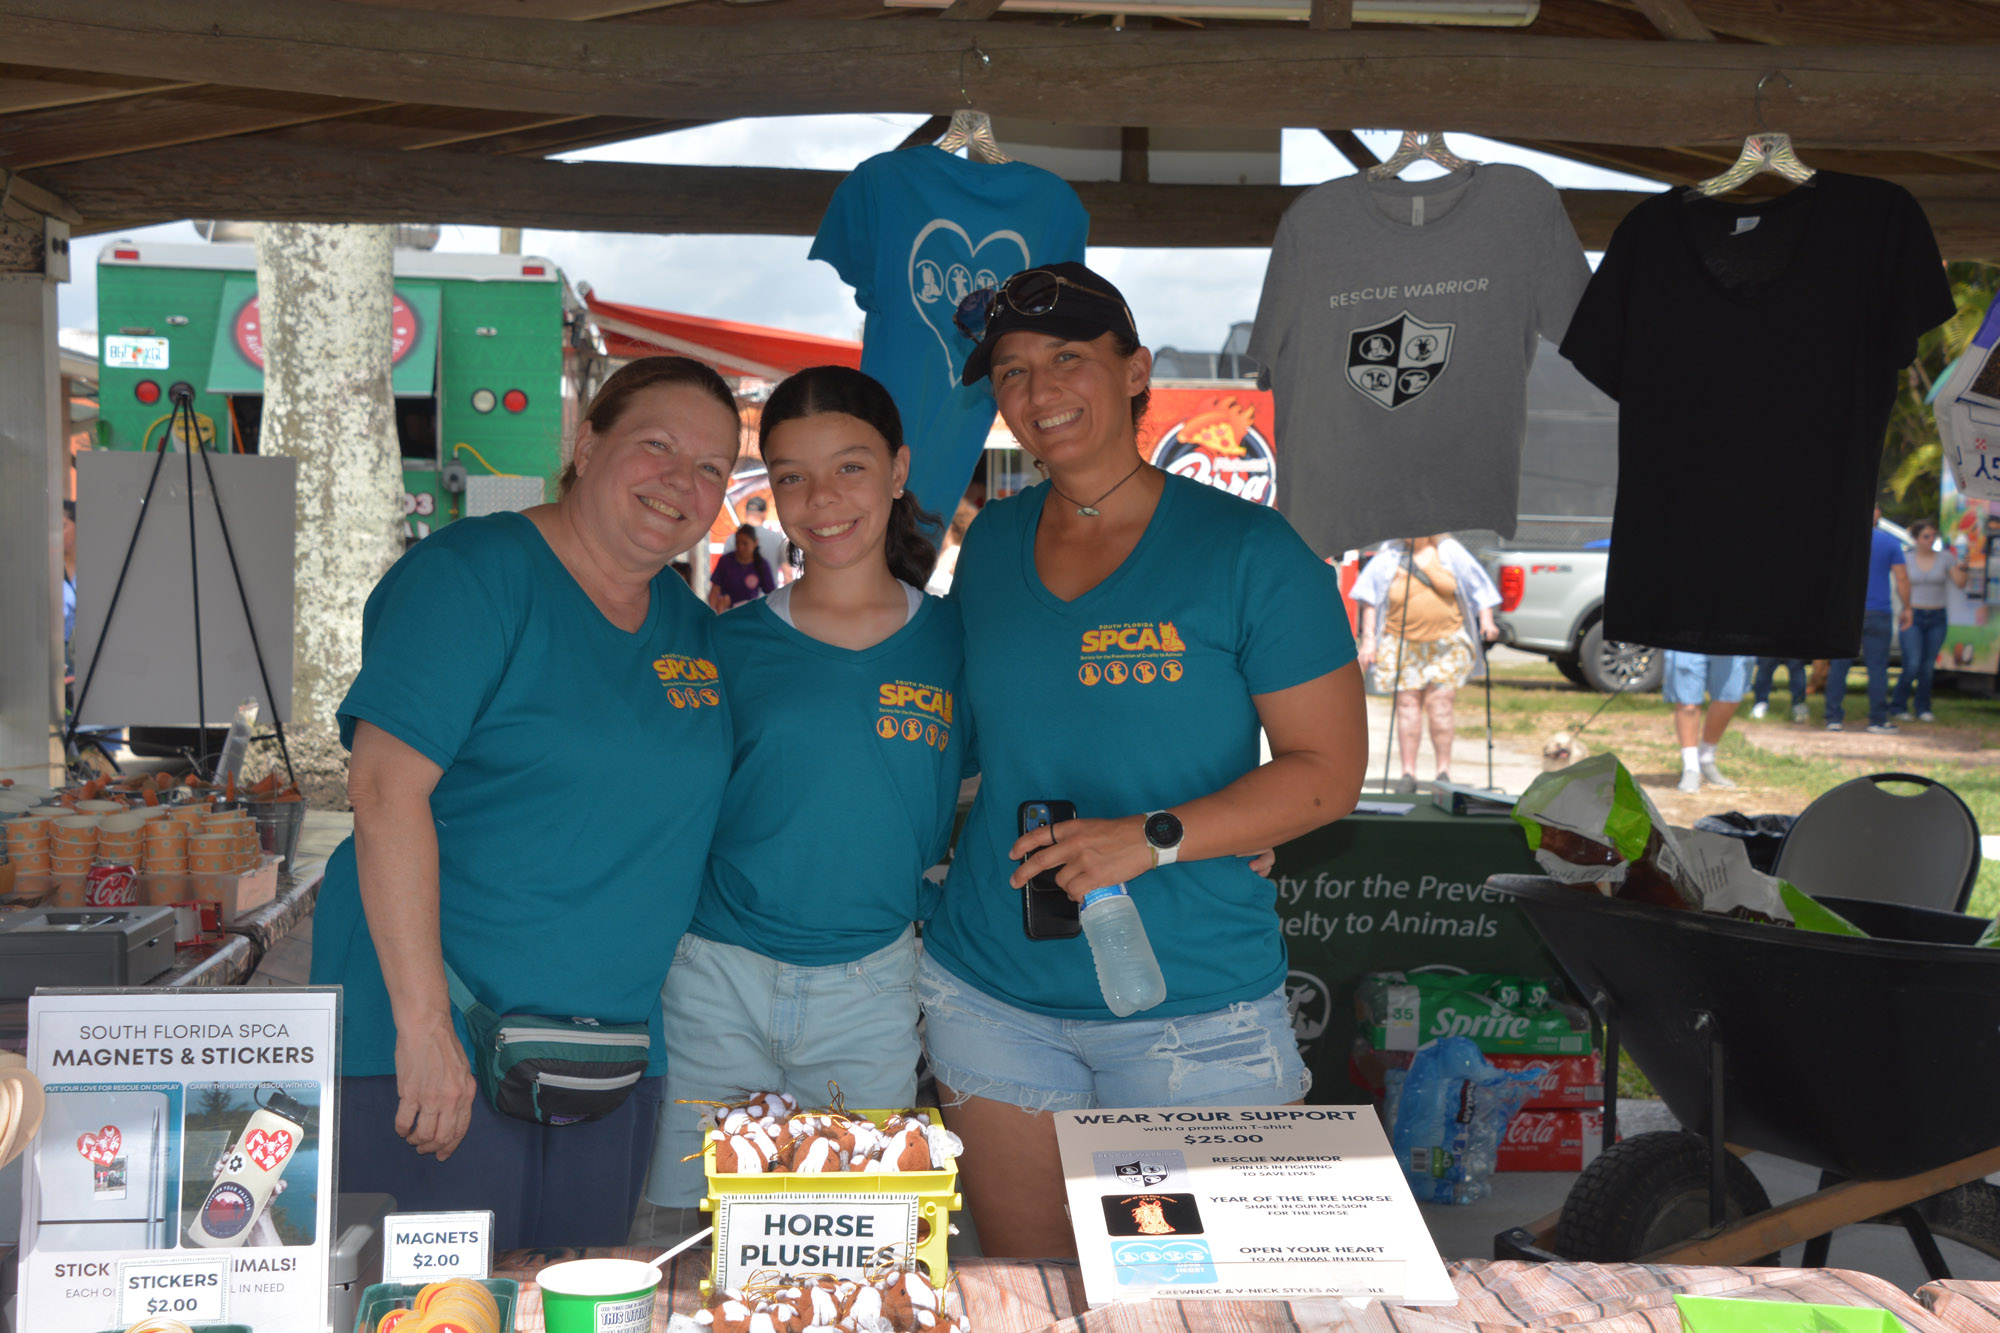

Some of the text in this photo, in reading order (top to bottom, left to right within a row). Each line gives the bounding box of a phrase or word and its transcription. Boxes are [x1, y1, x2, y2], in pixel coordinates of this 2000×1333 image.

[1330, 277, 1489, 308] RESCUE WARRIOR
[1081, 628, 1161, 653] SPCA
[652, 658, 709, 681] SPCA
[895, 680, 943, 694] SOUTH FLORIDA
[879, 683, 945, 718] SPCA
[1314, 872, 1355, 899] for
[1362, 873, 1410, 899] the
[1345, 912, 1374, 934] to
[1380, 909, 1498, 938] Animals
[1392, 1008, 1415, 1021] 35
[1429, 1006, 1530, 1038] Sprite
[80, 1023, 290, 1039] SOUTH FLORIDA SPCA
[52, 1046, 315, 1066] MAGNETS & STICKERS
[1073, 1110, 1357, 1125] WEAR YOUR SUPPORT
[1188, 1125, 1247, 1134] premium
[1183, 1134, 1264, 1145] $25.00
[764, 1213, 874, 1238] HORSE
[396, 1231, 479, 1245] MAGNETS
[413, 1253, 460, 1269] $2.00
[740, 1244, 895, 1268] PLUSHIES
[55, 1258, 297, 1277] STICK IMALS!
[128, 1273, 219, 1290] STICKERS
[65, 1288, 98, 1298] EACH
[239, 1284, 250, 1293] IN
[254, 1283, 285, 1293] NEED
[146, 1298, 198, 1315] $2.00
[601, 1311, 624, 1326] THIS
